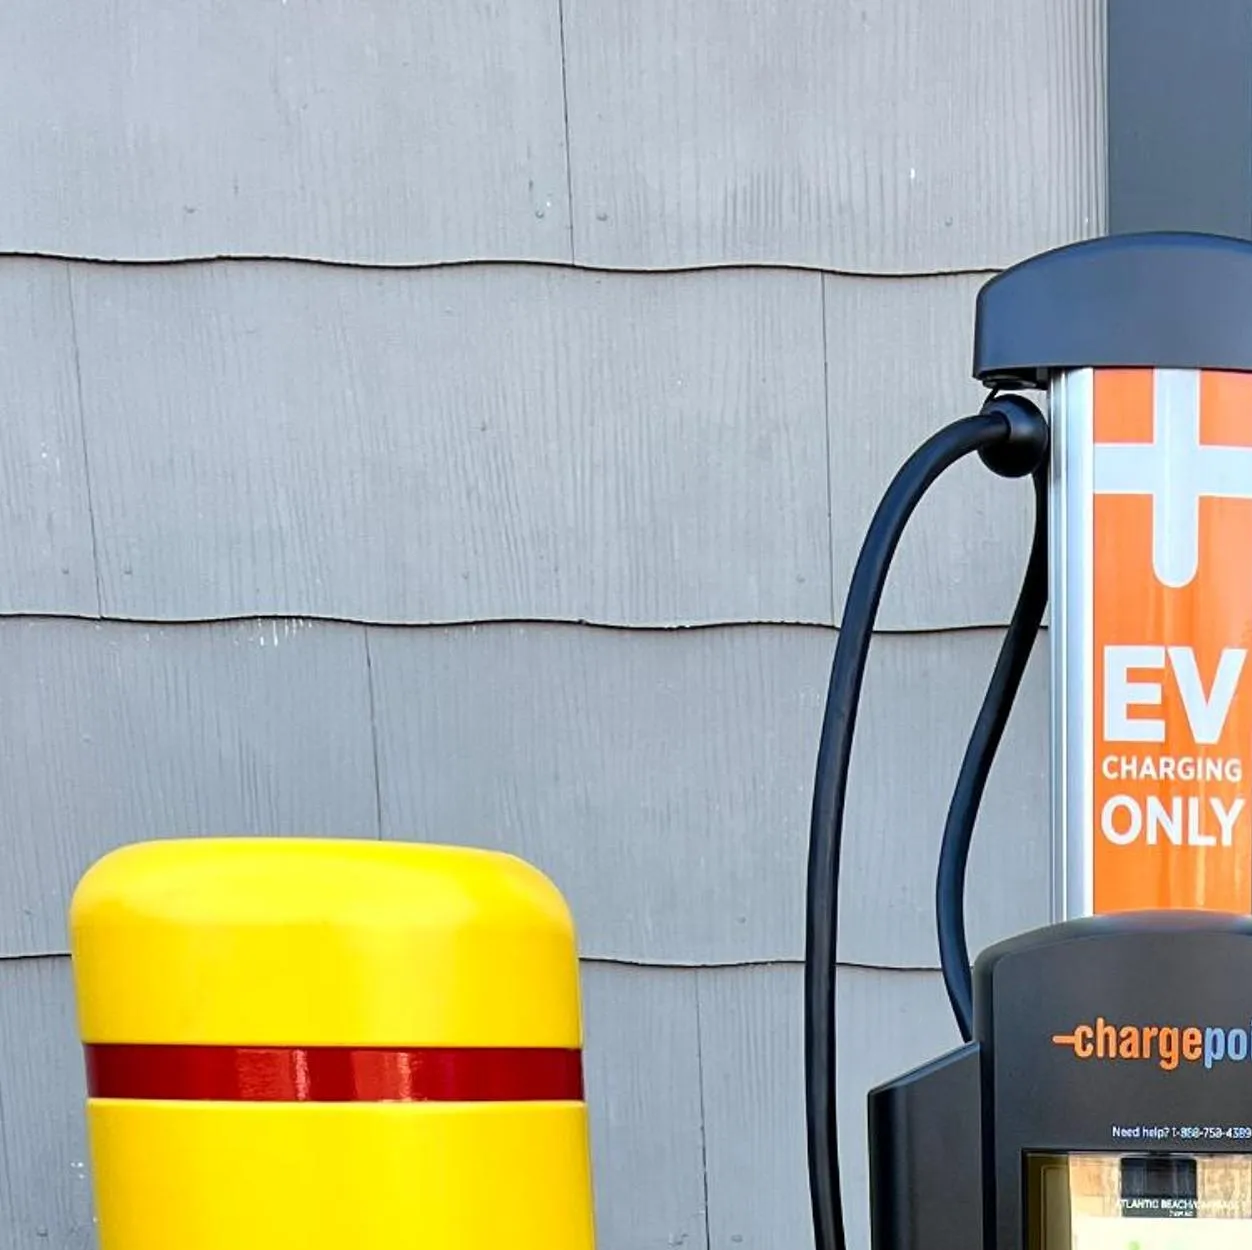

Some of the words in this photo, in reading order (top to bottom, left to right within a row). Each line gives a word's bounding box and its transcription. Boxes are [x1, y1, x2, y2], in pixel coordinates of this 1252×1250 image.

[1103, 645, 1248, 744] EV
[1101, 755, 1243, 783] CHARGING
[1100, 794, 1246, 846] ONLY
[1112, 1126, 1140, 1138] Need
[1142, 1126, 1169, 1139] help?
